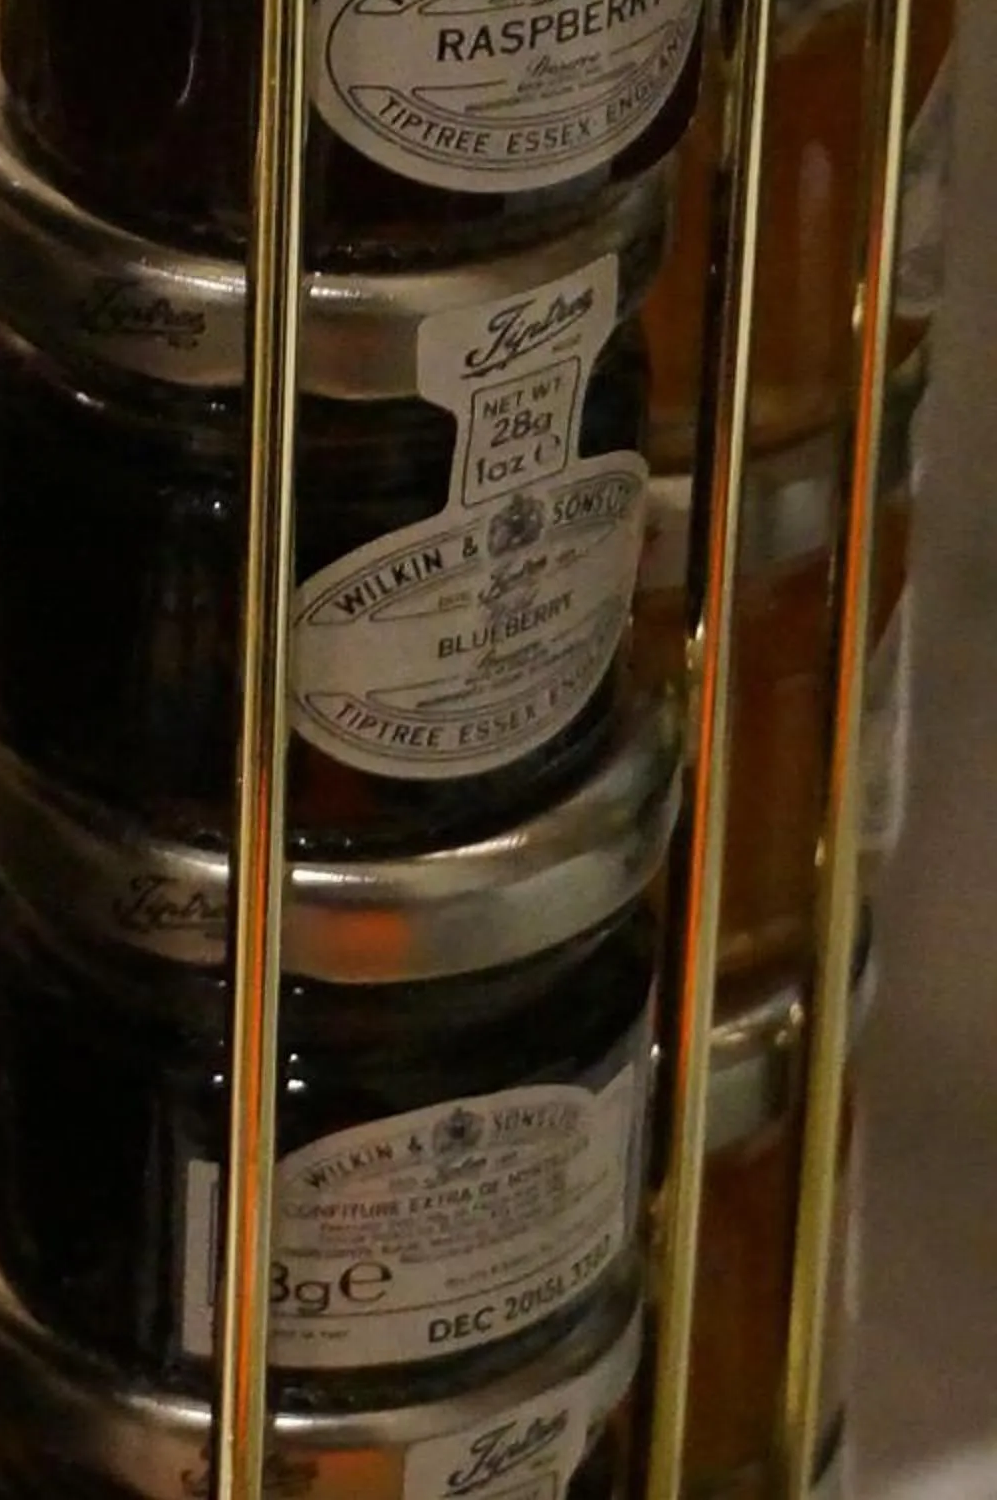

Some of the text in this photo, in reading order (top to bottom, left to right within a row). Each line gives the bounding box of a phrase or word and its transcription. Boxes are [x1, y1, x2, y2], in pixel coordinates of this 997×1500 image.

[374, 95, 491, 155] TIPTREE
[506, 116, 591, 155] ESSEX
[490, 410, 552, 449] 28g
[333, 547, 444, 616] WILKIN
[437, 591, 576, 659] BLUEBERRY
[334, 701, 444, 747] TIPTREE
[428, 1306, 496, 1344] DEC
